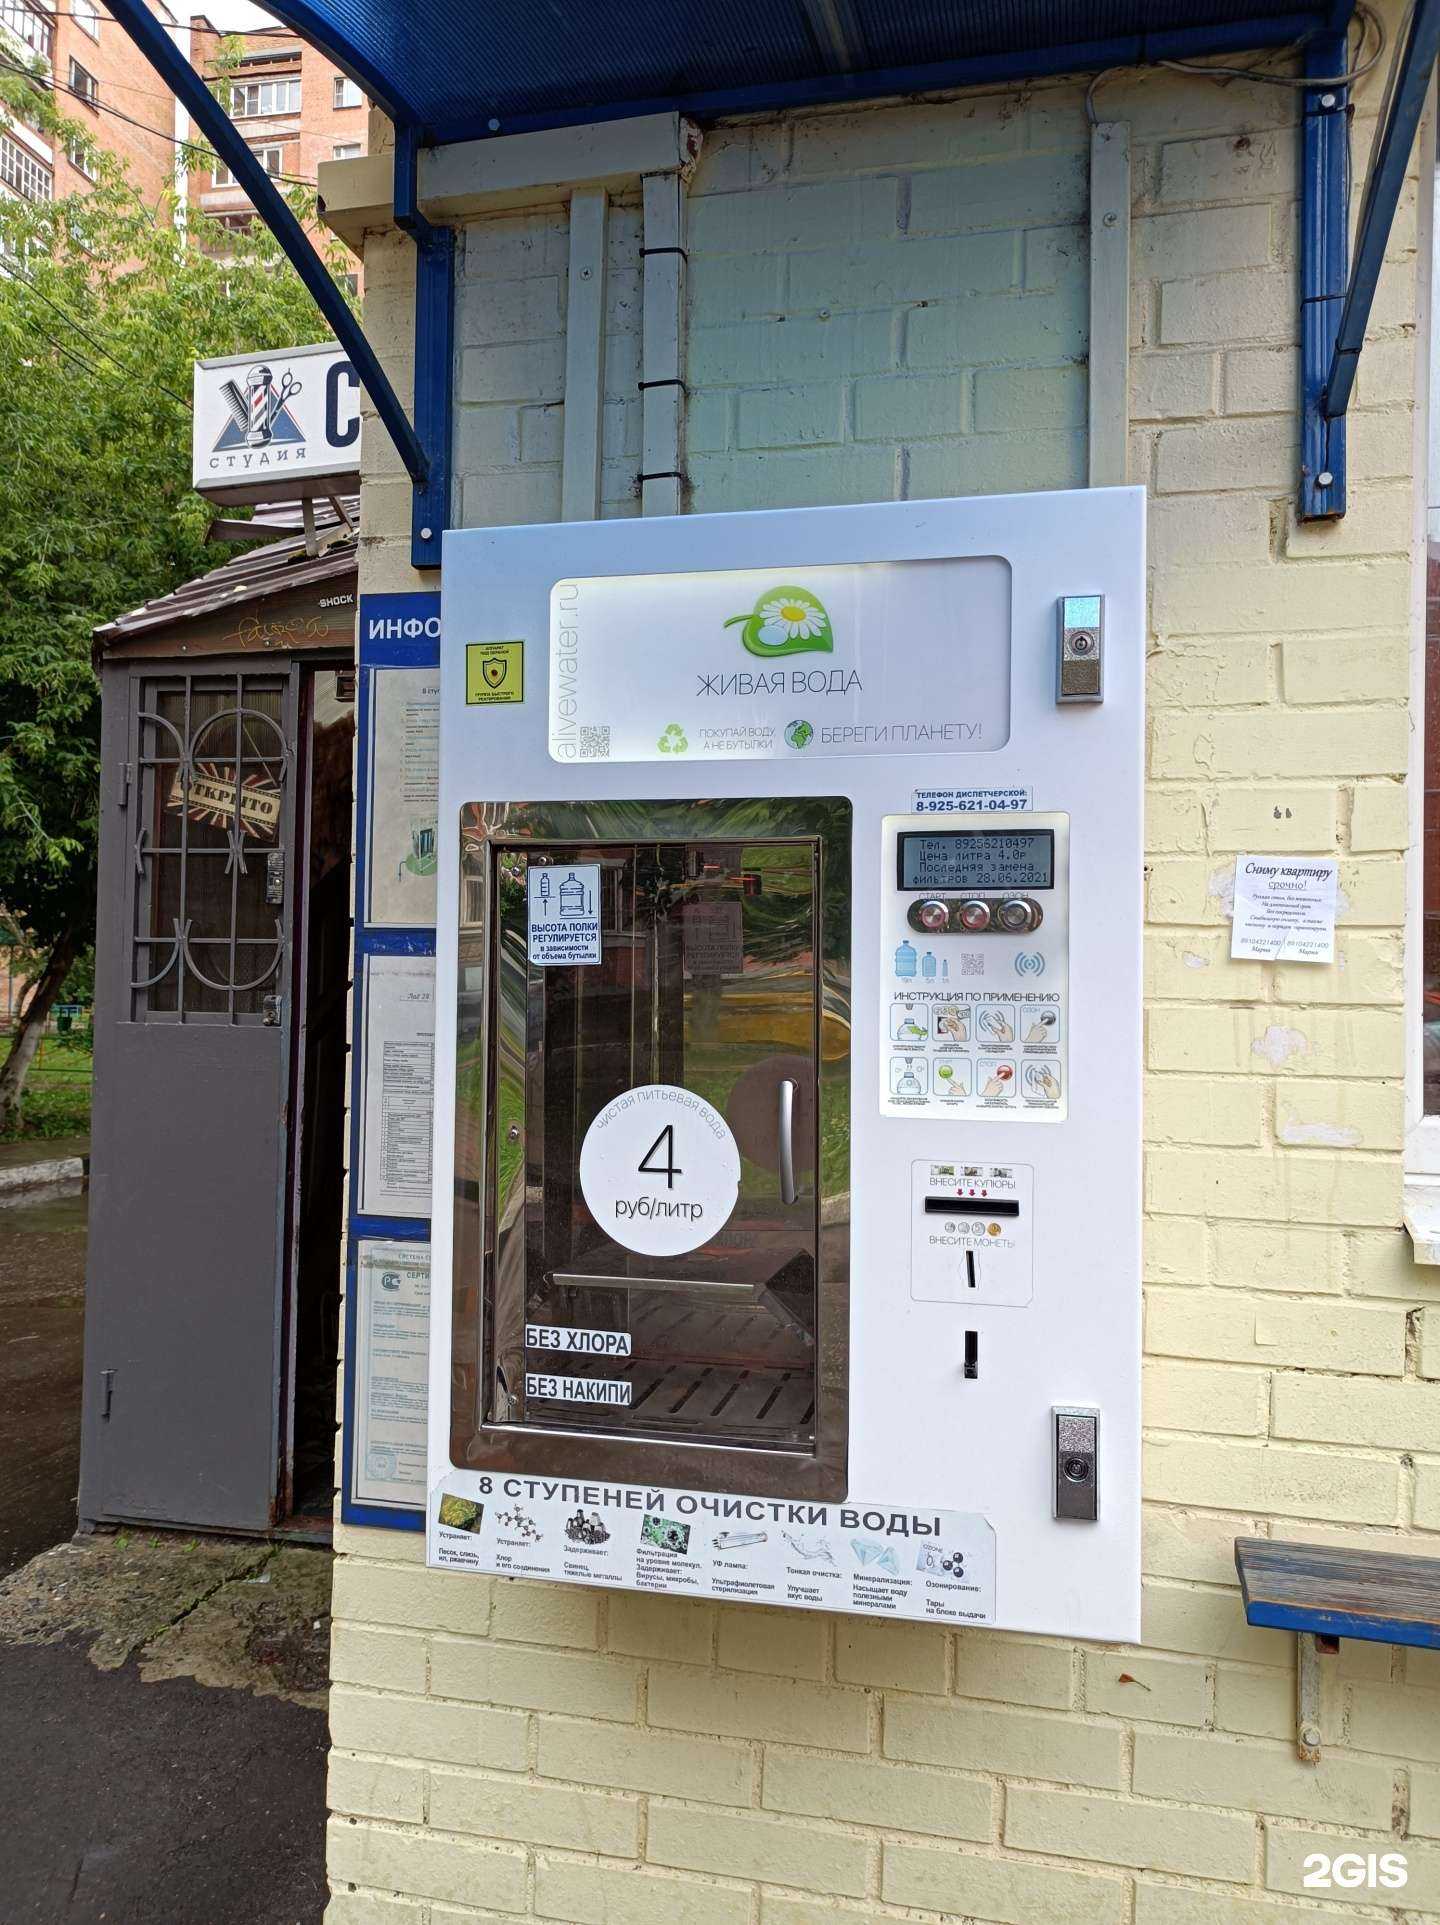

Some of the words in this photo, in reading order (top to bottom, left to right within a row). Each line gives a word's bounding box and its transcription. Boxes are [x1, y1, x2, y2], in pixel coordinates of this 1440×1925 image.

[319, 594, 354, 608] SHOCK
[551, 583, 579, 759] alivewater.ru
[696, 672, 785, 697] ЖИВАЯ
[792, 669, 863, 695] ВОДА
[699, 726, 748, 738] ПОКУПАЙ
[749, 726, 776, 738] ВОДУ
[821, 726, 888, 744] БЕРЕГИ
[891, 722, 983, 743] ПЛАНЕТУ!
[726, 740, 773, 749] БУТЫЛКИ
[917, 791, 953, 799] ТЕЛЕФОН
[955, 789, 1027, 799] ДИСПЕТЧЕРСКОЙ:
[916, 799, 1027, 811] 8-925-621-04-97
[920, 839, 946, 850] Тел.
[955, 838, 1034, 850] 89256210497
[919, 851, 948, 862] Цена
[955, 851, 991, 861] литра
[919, 862, 983, 873] Последняя
[991, 862, 1035, 872] замена
[1245, 862, 1280, 879] Сниму
[1281, 867, 1333, 882] квартиру
[976, 872, 1048, 883] 28.06.2021
[1268, 880, 1307, 891] срочно!
[531, 923, 568, 933] ВЫСОТА
[570, 922, 598, 932] ПОЛКИ
[532, 932, 597, 943] РЕГУЛИРУЕТСЯ
[545, 944, 589, 952] зависимости
[568, 951, 597, 961] бутылки
[894, 992, 963, 1002] ИНСТРУКЦИЯ
[965, 992, 981, 1002] ПО
[983, 992, 1060, 1002] ПРИМЕНЕНИЮ
[596, 1095, 636, 1129] чистая
[636, 1089, 700, 1111] питьевая
[699, 1107, 726, 1140] вода
[638, 1124, 682, 1189] 4
[929, 1177, 973, 1188] ВНЕСИТЕ
[974, 1179, 1016, 1189] КУПЮРЫ
[615, 1197, 703, 1222] руб/литр
[929, 1235, 973, 1246] ВНЕСИТЕ
[526, 1328, 561, 1349] БЕЗ
[566, 1331, 629, 1355] ХЛОРА
[526, 1376, 557, 1397] БЕЗ
[563, 1379, 631, 1404] НАКИПИ
[479, 1476, 493, 1495] 8
[503, 1478, 665, 1512] СТУПЕНЕЙ
[676, 1494, 828, 1527] ОЧИСТКИ
[840, 1508, 941, 1538] ВОДЫ
[438, 1530, 473, 1541] Устраняет:
[496, 1537, 531, 1548] Устраняет:
[438, 1547, 459, 1557] Песок,
[563, 1544, 609, 1556] Задерживает:
[636, 1547, 678, 1558] Фильтрация
[449, 1556, 480, 1567] ржавчину
[496, 1553, 512, 1563] Хлор
[646, 1558, 670, 1567] уровне
[712, 1559, 723, 1567] УФ
[502, 1562, 512, 1570] его
[636, 1564, 683, 1575] Задерживает:
[593, 1572, 623, 1581] металлы
[786, 1566, 811, 1576] Тонкая
[812, 1569, 843, 1579] очистка:
[636, 1579, 668, 1589] бактерии
[712, 1577, 775, 1590] Ультрафиолетовая
[853, 1573, 913, 1586] Минерализация:
[711, 1585, 758, 1596] стерилизация
[787, 1584, 820, 1595] Улучшает
[853, 1584, 888, 1594] Насыщает
[890, 1589, 908, 1598] воду
[925, 1579, 982, 1593] Озонирование:
[804, 1594, 823, 1602] воды
[853, 1593, 893, 1602] полезными
[926, 1598, 945, 1608] Тары
[853, 1600, 897, 1610] минералами
[958, 1611, 986, 1620] выдачи
